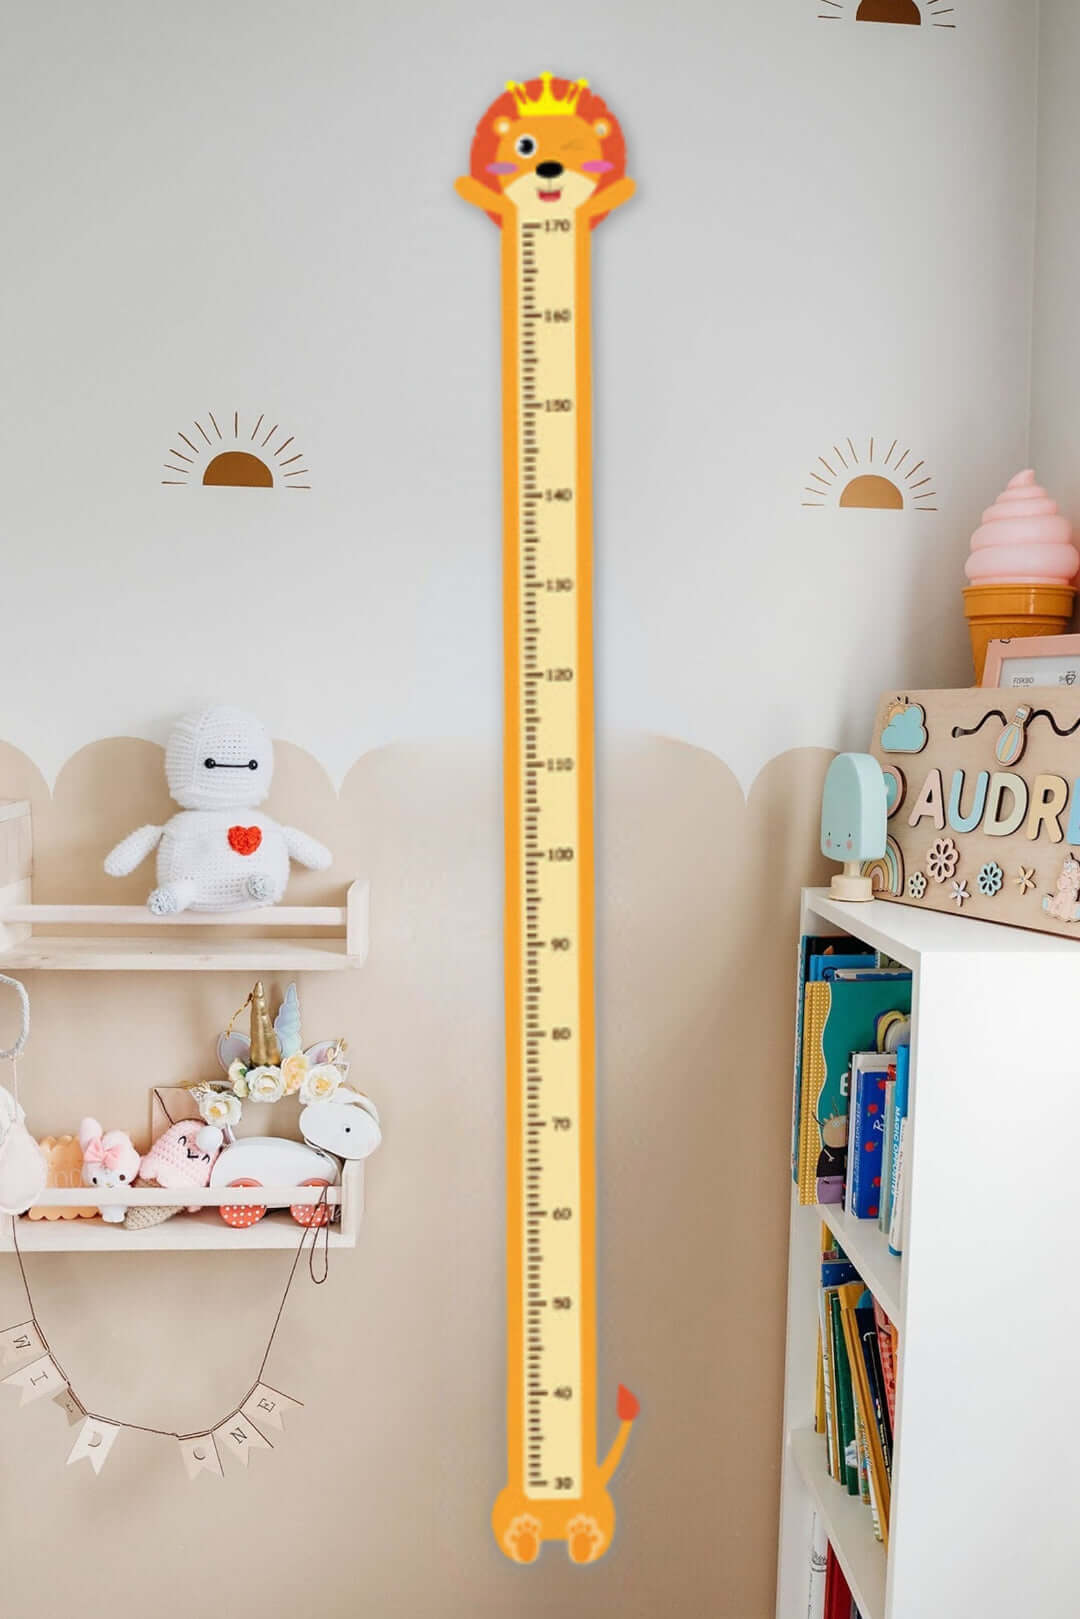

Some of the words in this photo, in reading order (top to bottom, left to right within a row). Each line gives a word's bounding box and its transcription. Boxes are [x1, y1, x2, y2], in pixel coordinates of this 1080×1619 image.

[545, 219, 571, 232] 170
[545, 488, 572, 502] 140
[546, 668, 573, 682] 120
[548, 847, 574, 862] 100
[551, 937, 571, 951] 90
[552, 1117, 571, 1131] 70
[552, 1208, 572, 1221] 60
[552, 1296, 572, 1310] 50
[553, 1386, 572, 1400] 40
[553, 1477, 573, 1490] 30
